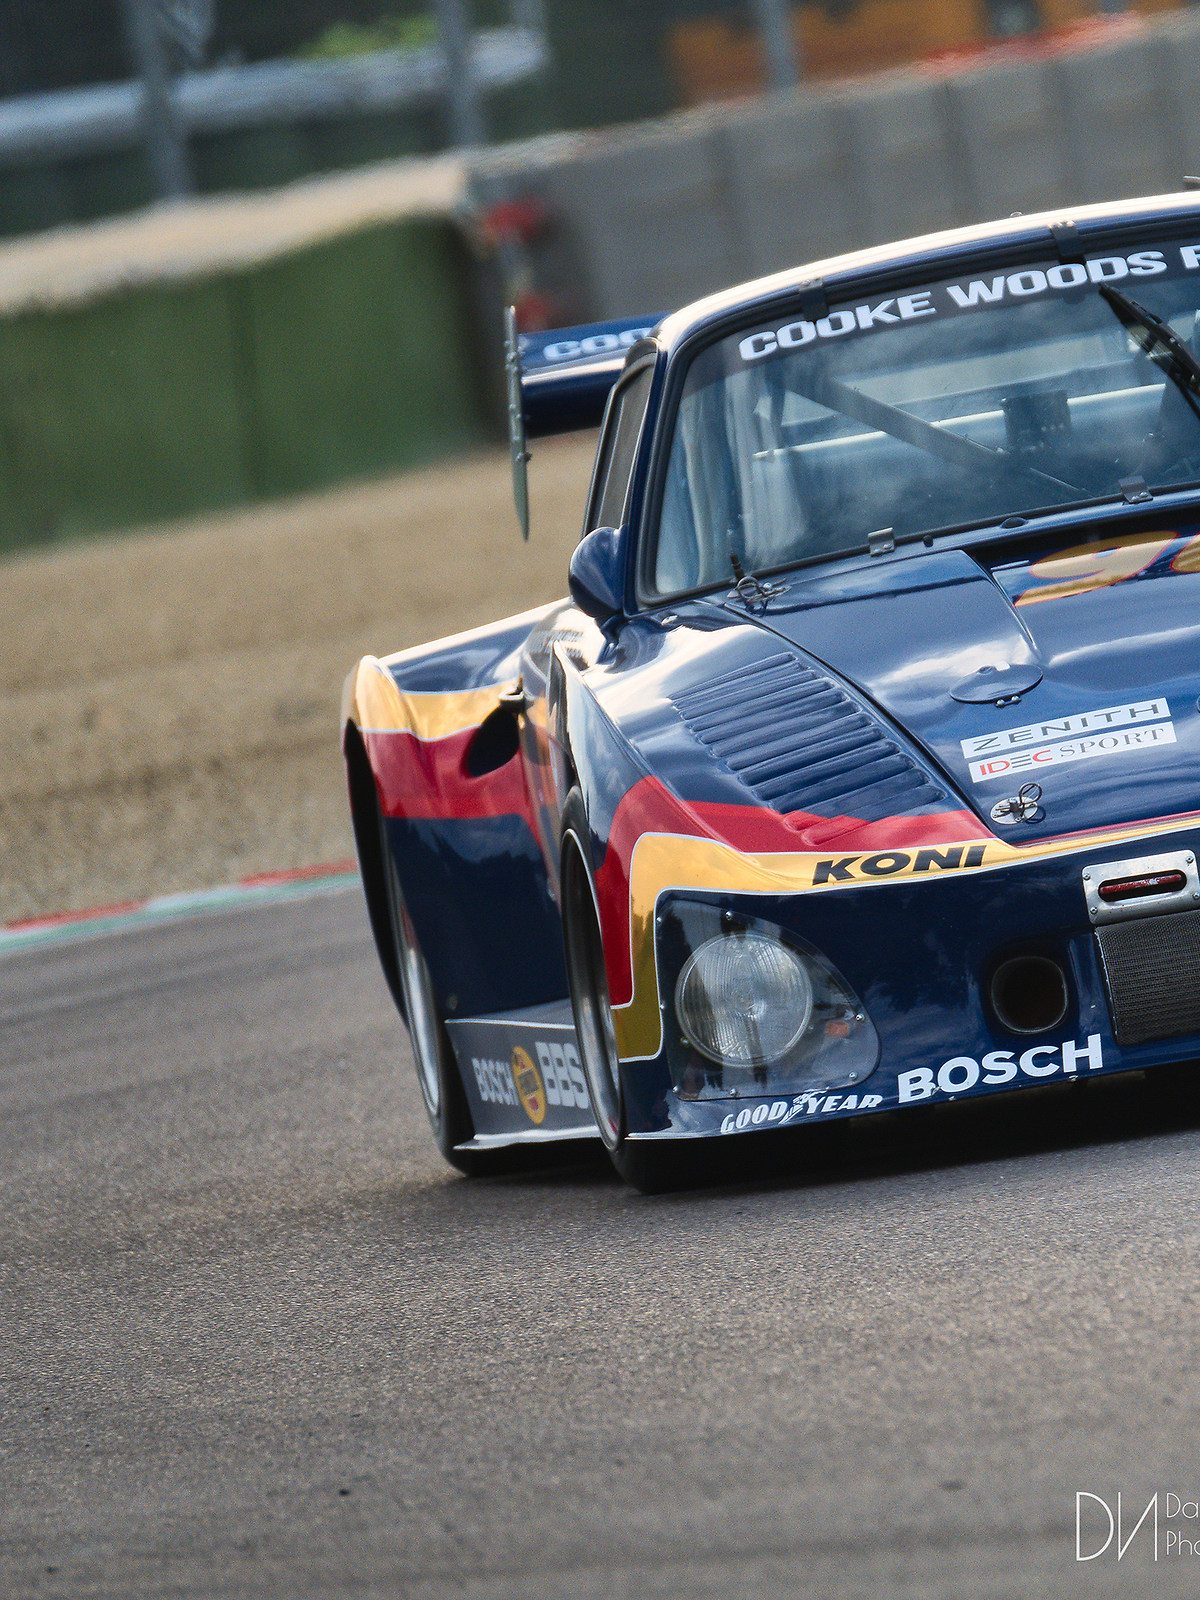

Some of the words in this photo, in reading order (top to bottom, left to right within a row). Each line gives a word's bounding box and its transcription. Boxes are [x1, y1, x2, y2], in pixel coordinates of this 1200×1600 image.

[739, 291, 937, 361] COOKE
[946, 250, 1167, 307] WOODS
[972, 703, 1160, 753] ZENITH
[979, 749, 1053, 776] IDEC
[1058, 727, 1166, 759] SPORT
[811, 845, 989, 886] KONI
[471, 1057, 519, 1106] BOSCH
[535, 1041, 589, 1110] BBS
[897, 1034, 1104, 1105] BOSCH
